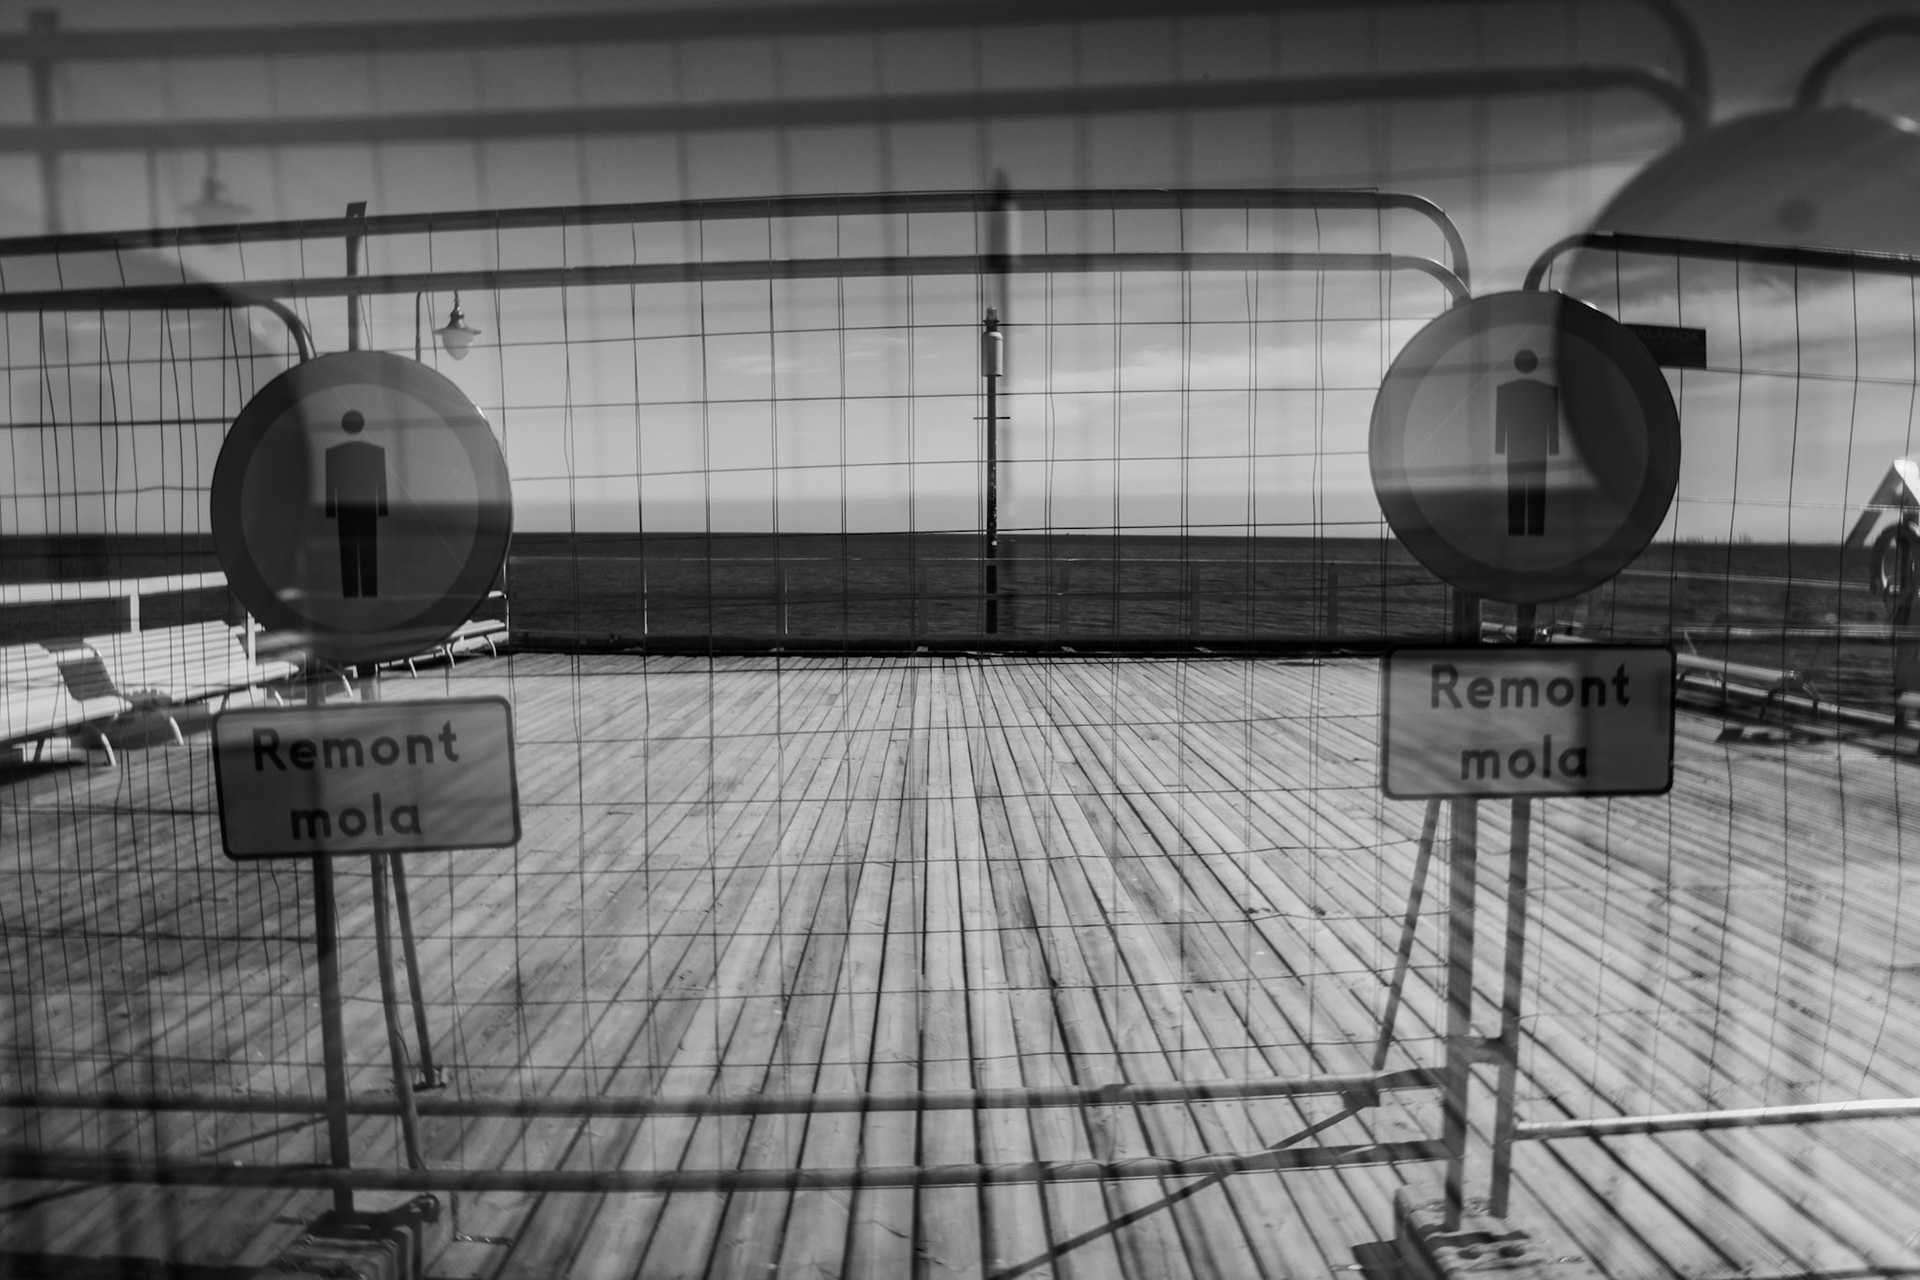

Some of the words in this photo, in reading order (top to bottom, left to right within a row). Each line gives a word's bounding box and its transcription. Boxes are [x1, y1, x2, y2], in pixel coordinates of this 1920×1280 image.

[1430, 662, 1631, 709] Remont
[252, 720, 460, 772] Remont
[1460, 734, 1588, 780] mola
[291, 792, 421, 840] mola
